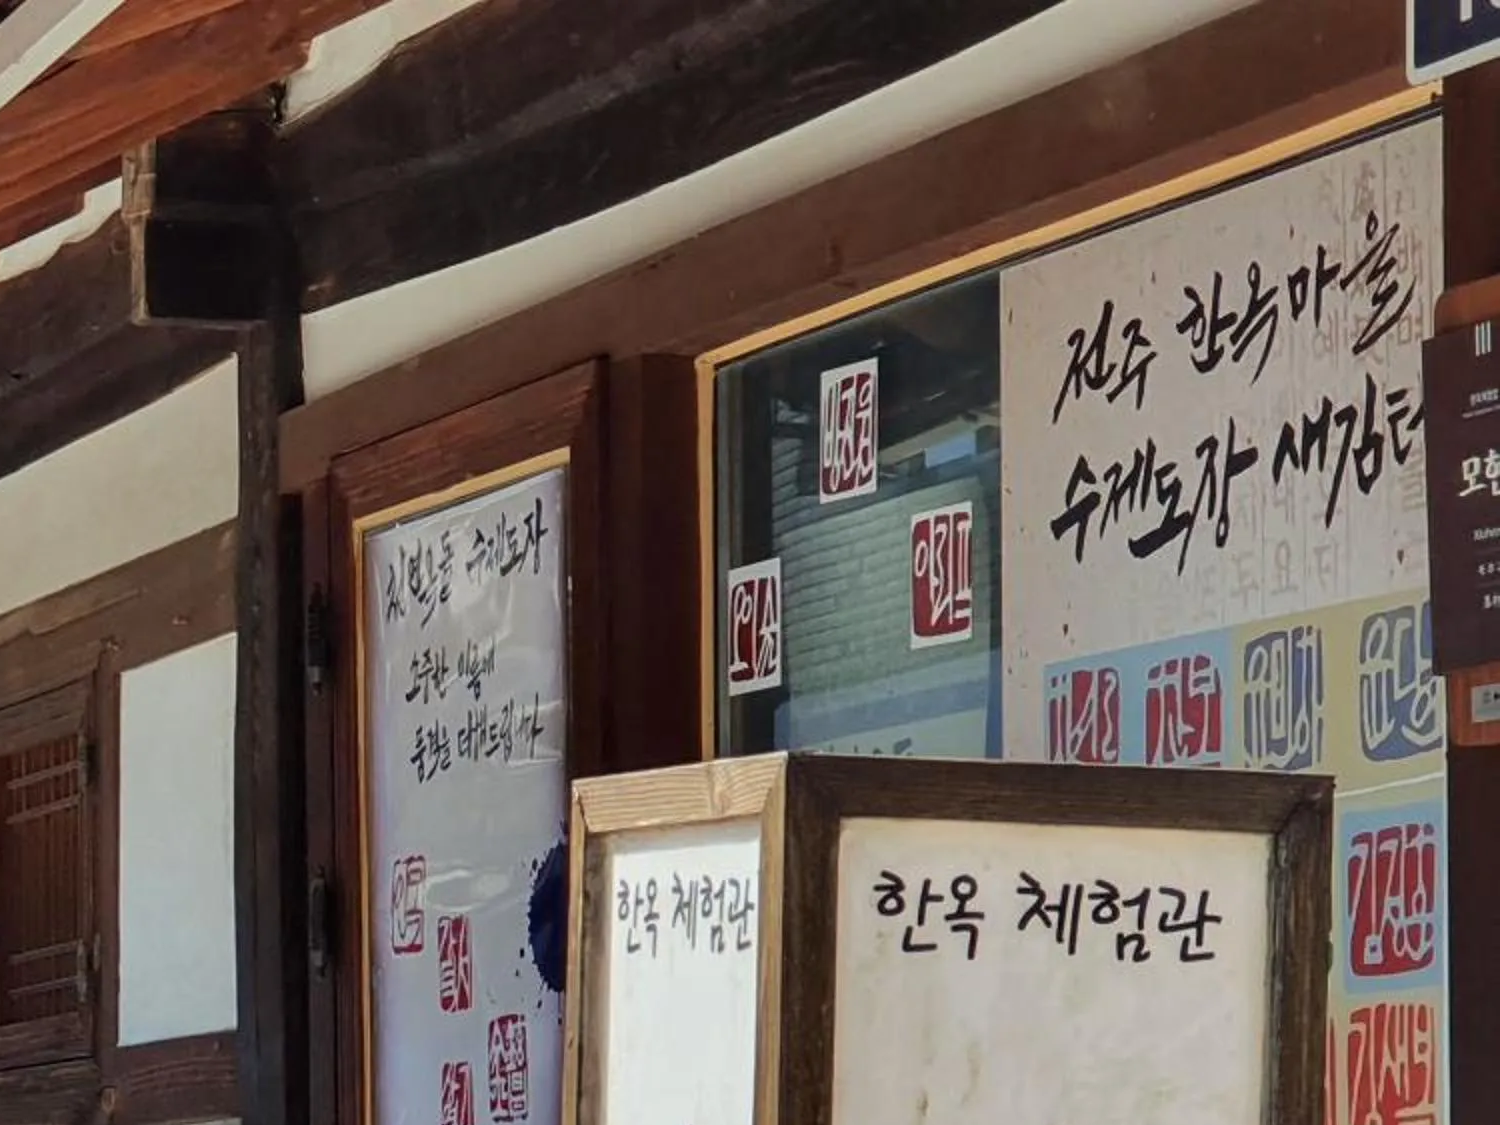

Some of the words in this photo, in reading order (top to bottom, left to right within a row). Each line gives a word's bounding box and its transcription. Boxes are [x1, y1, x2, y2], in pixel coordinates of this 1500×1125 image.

[1053, 300, 1157, 425] 전주
[1176, 209, 1417, 385] 한옥마을
[1050, 415, 1260, 576] 수제도장
[616, 874, 660, 958] 한옥
[670, 872, 756, 953] 체험관
[873, 870, 985, 960] 한옥
[1016, 871, 1222, 963] 체험관
